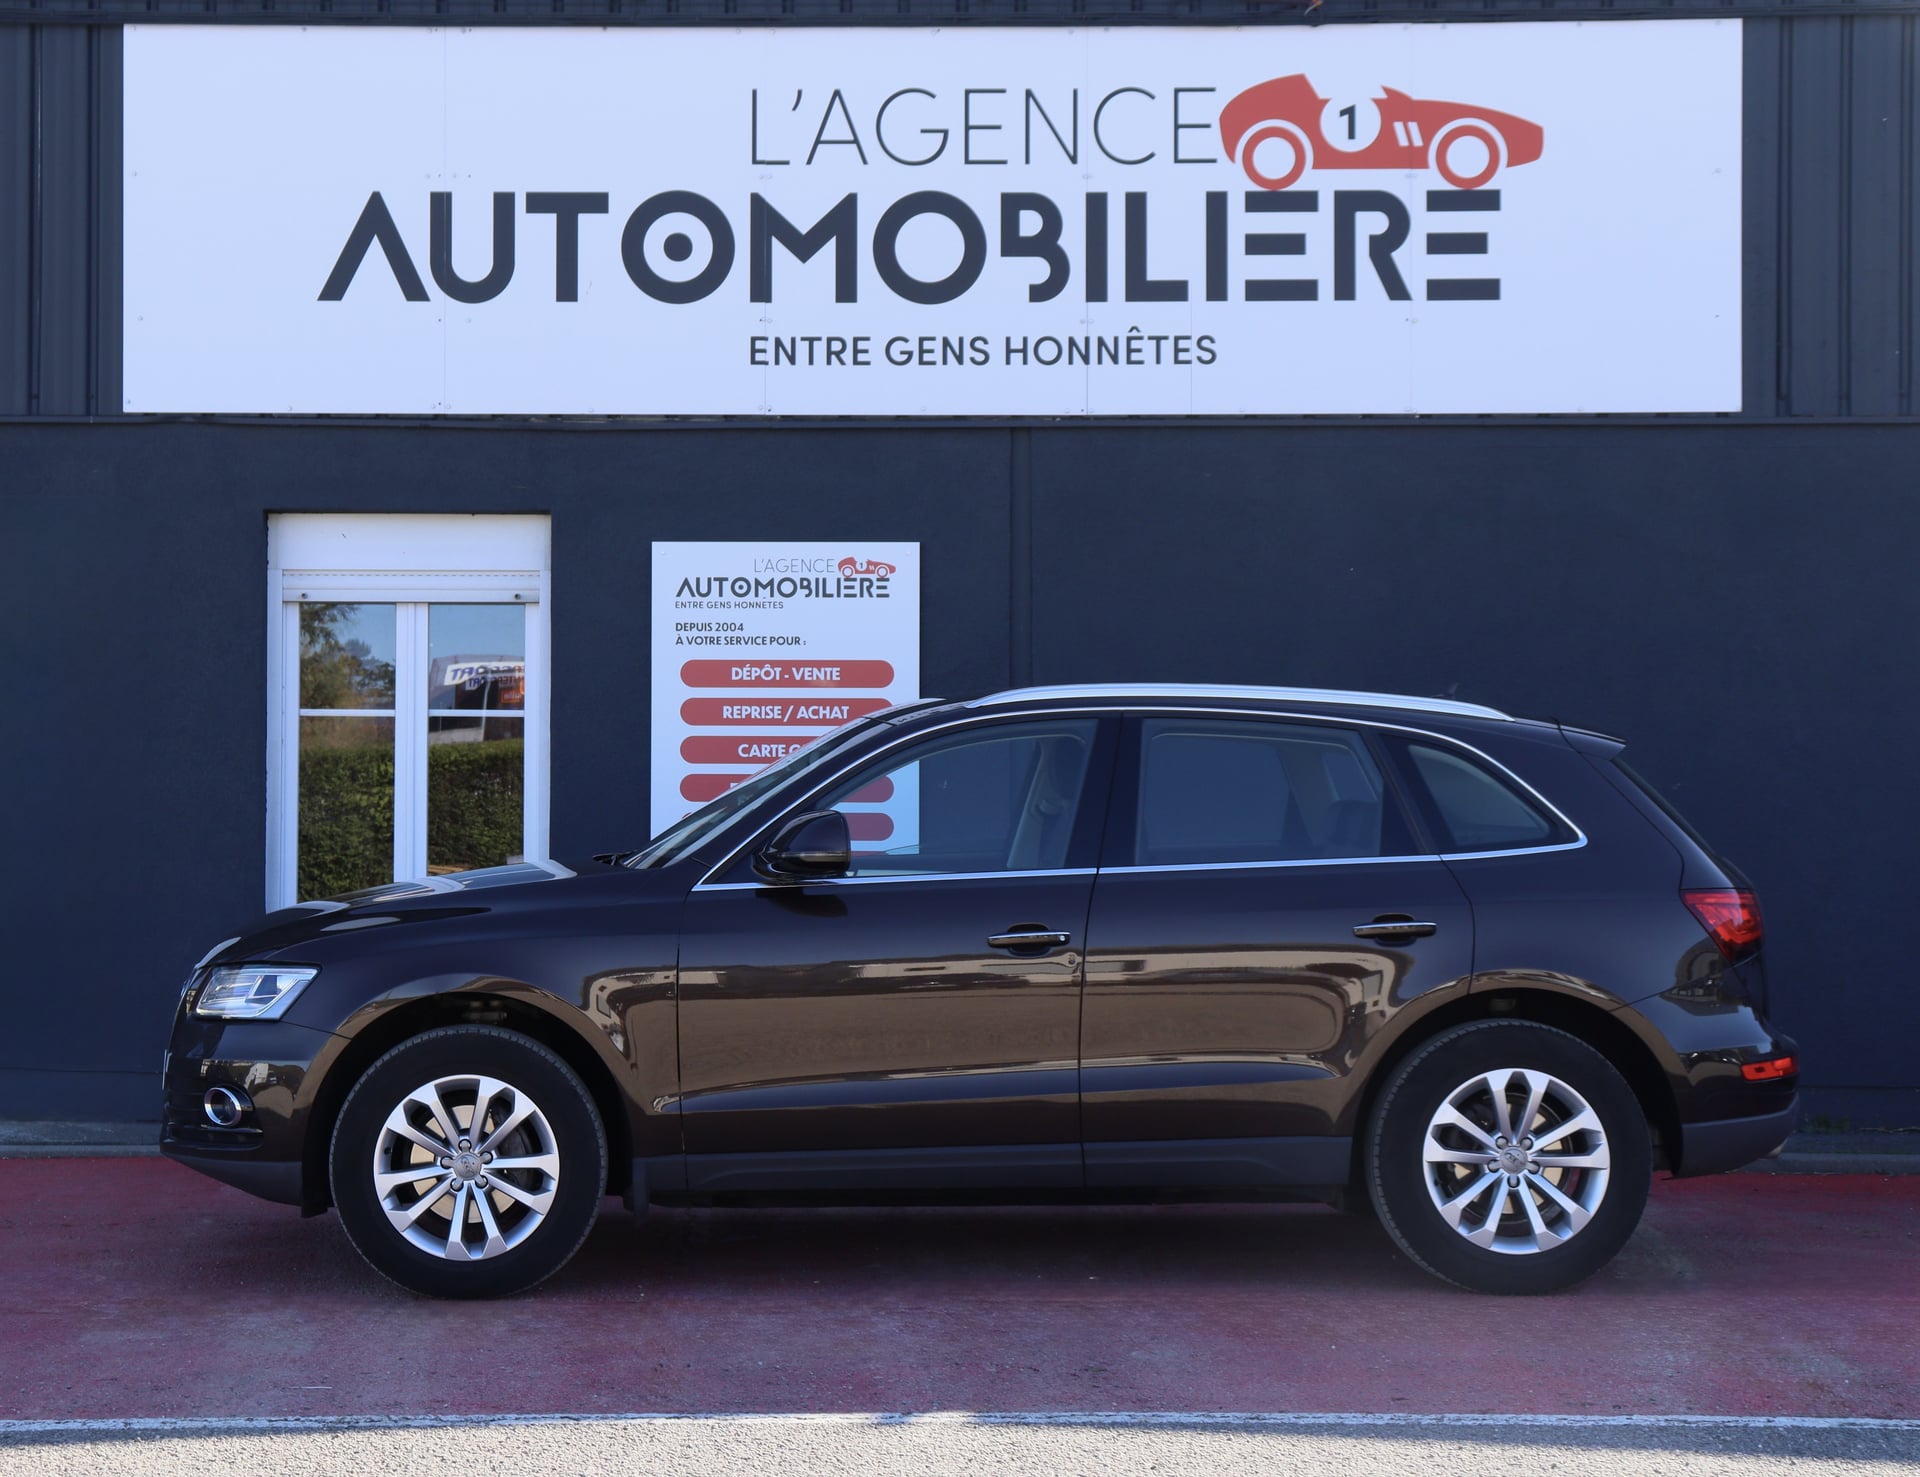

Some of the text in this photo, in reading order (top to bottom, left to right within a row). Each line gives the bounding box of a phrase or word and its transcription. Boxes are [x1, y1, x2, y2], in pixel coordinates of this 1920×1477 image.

[751, 87, 1218, 167] L'AGENCE
[1337, 104, 1357, 141] 1
[317, 189, 1501, 305] AUTOMOBILIERE
[750, 325, 1217, 366] ENTRE GENS HONNÊTES
[753, 558, 835, 574] L'AGENCE
[676, 577, 889, 598] AUTOMOBILIERE
[675, 597, 784, 609] ENTRE GENS HONNÊTES
[675, 622, 744, 633] DEPUIS 2004
[675, 633, 684, 646] À
[686, 635, 722, 646] VOTRE
[723, 635, 768, 646] SERVICE
[769, 635, 801, 646] POUR
[731, 663, 782, 681] DÉPÔT
[791, 666, 841, 681] VENTE
[722, 705, 782, 720] REPRISE
[796, 705, 850, 720] ACHAT
[737, 743, 786, 758] CARTE
